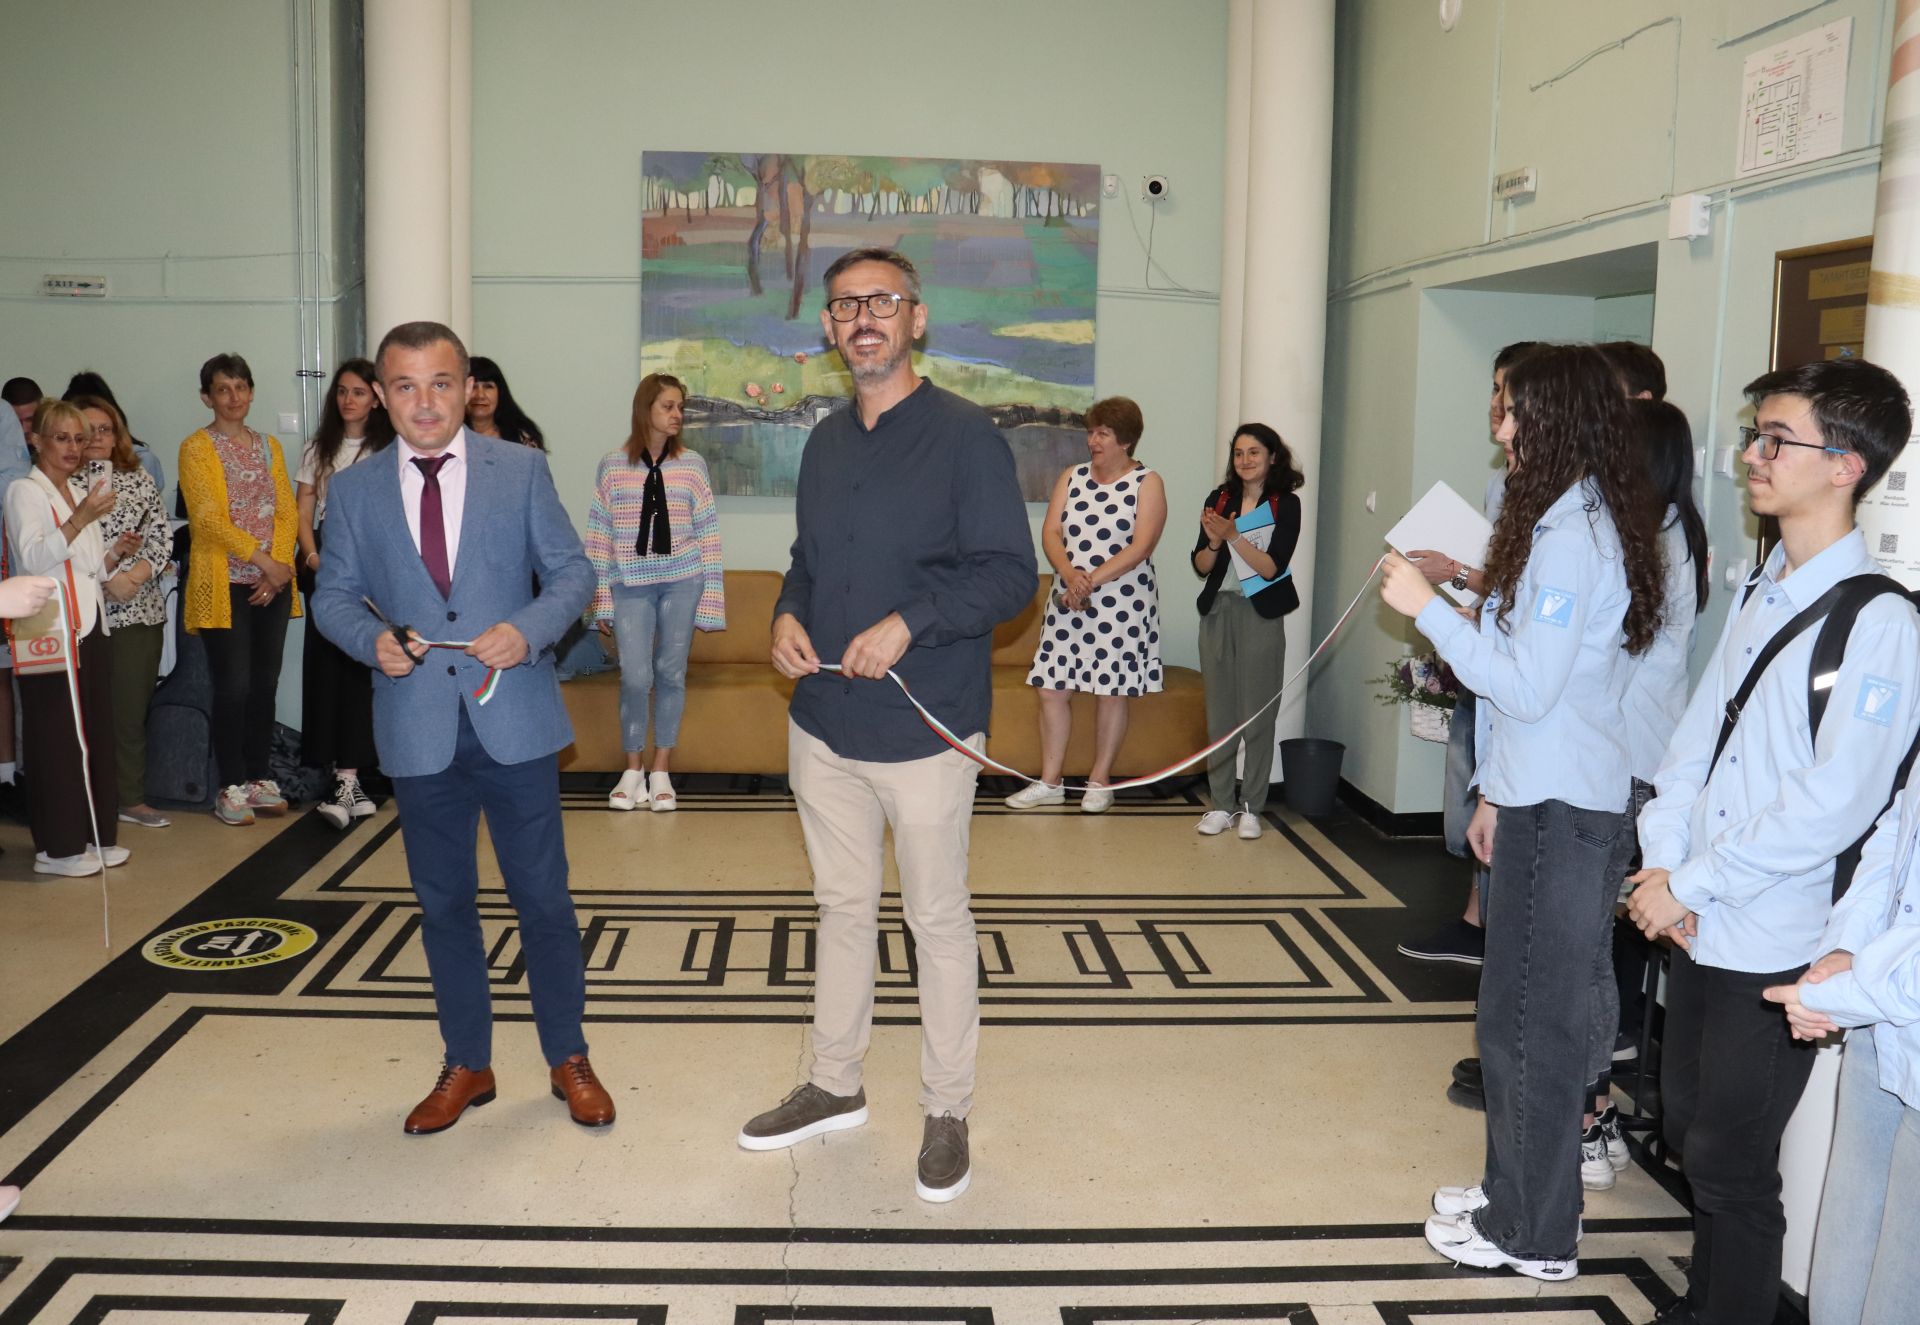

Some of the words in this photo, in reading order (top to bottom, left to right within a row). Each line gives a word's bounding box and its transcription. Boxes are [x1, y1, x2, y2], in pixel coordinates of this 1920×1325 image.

[48, 280, 74, 288] EXIT
[153, 925, 210, 957] БЕЗОПАСНО
[163, 955, 181, 963] НА
[183, 952, 281, 967] ЗАСТАНЕТЕ
